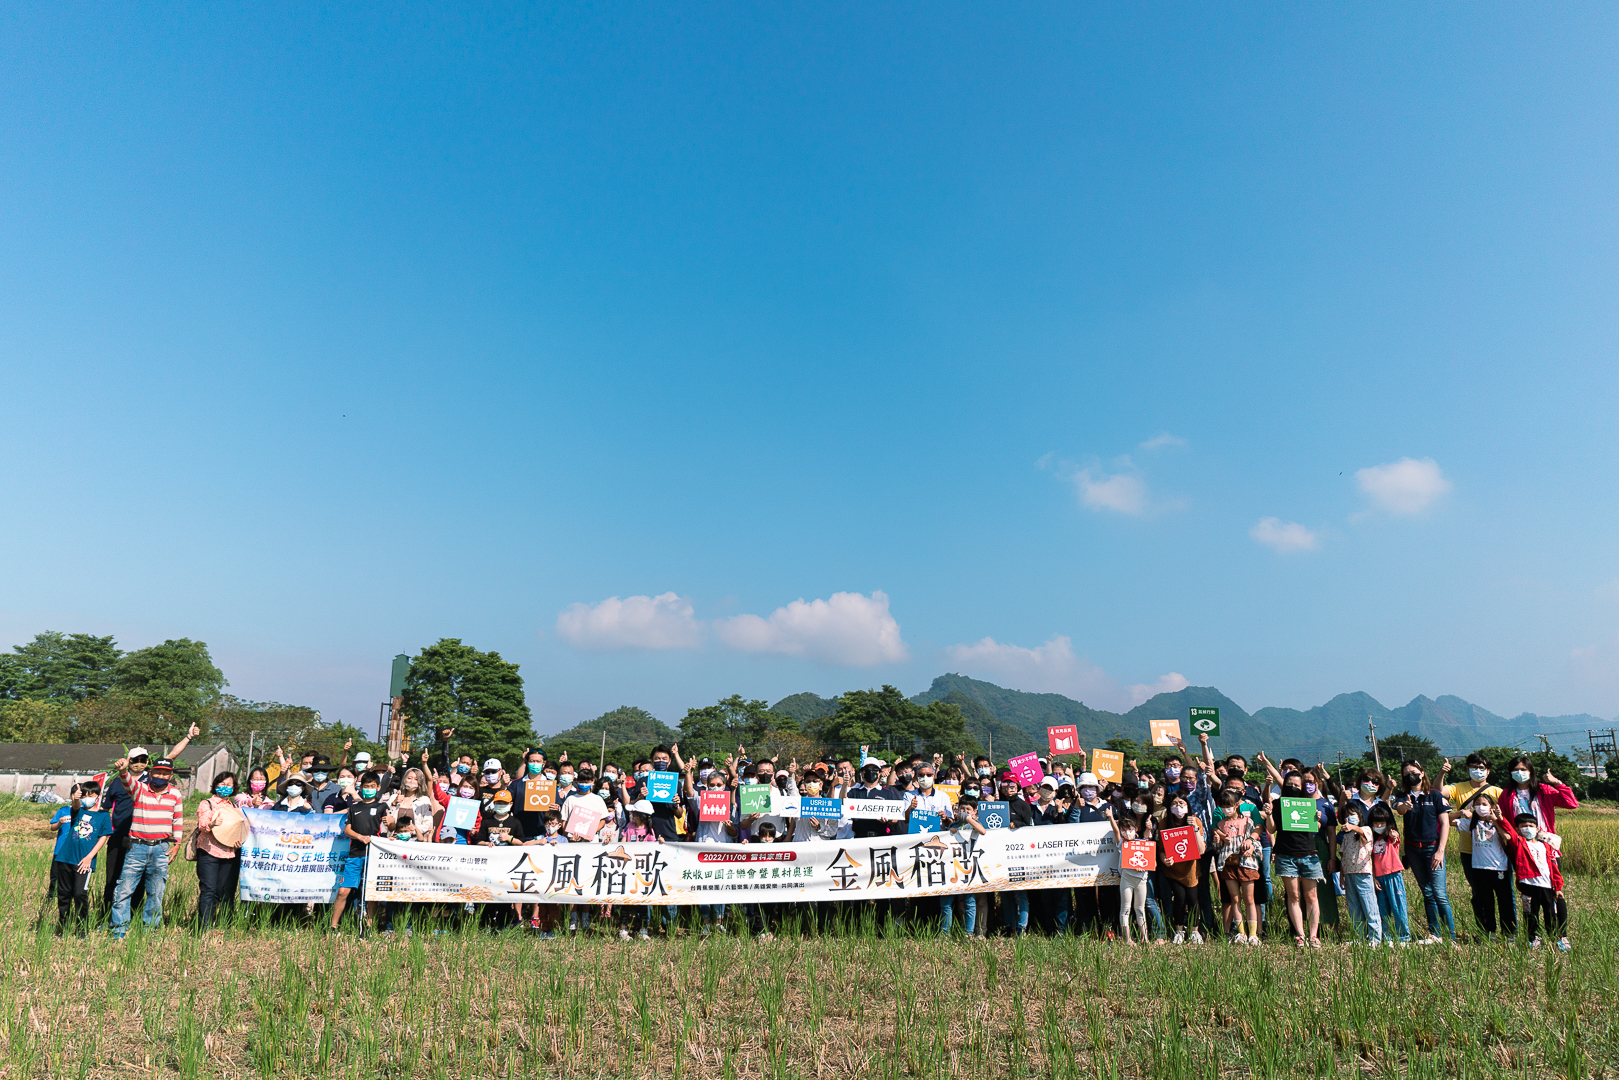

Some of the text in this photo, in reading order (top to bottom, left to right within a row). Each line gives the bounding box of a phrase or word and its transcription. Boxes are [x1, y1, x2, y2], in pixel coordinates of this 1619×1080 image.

[1191, 708, 1197, 716] 13
[1094, 751, 1099, 759] 2
[1009, 759, 1017, 768] 10
[649, 772, 656, 781] 14
[527, 781, 534, 790] 12
[742, 786, 747, 794] 3
[979, 803, 986, 811] 17
[1282, 799, 1290, 807] 15
[856, 804, 885, 813] LASER
[886, 805, 903, 814] TEK
[911, 811, 918, 819] 16
[280, 833, 314, 845] USR
[1163, 832, 1169, 840] 5
[1005, 843, 1025, 851] 2022
[1037, 840, 1063, 849] LASER
[1064, 839, 1079, 847] TEK
[378, 852, 398, 860] 2022
[408, 854, 436, 862] LASER
[437, 855, 453, 863] TEK
[703, 853, 747, 861] 2022/11/06
[825, 837, 989, 892] 金風稻歌
[506, 846, 668, 896] 金風稻歌
